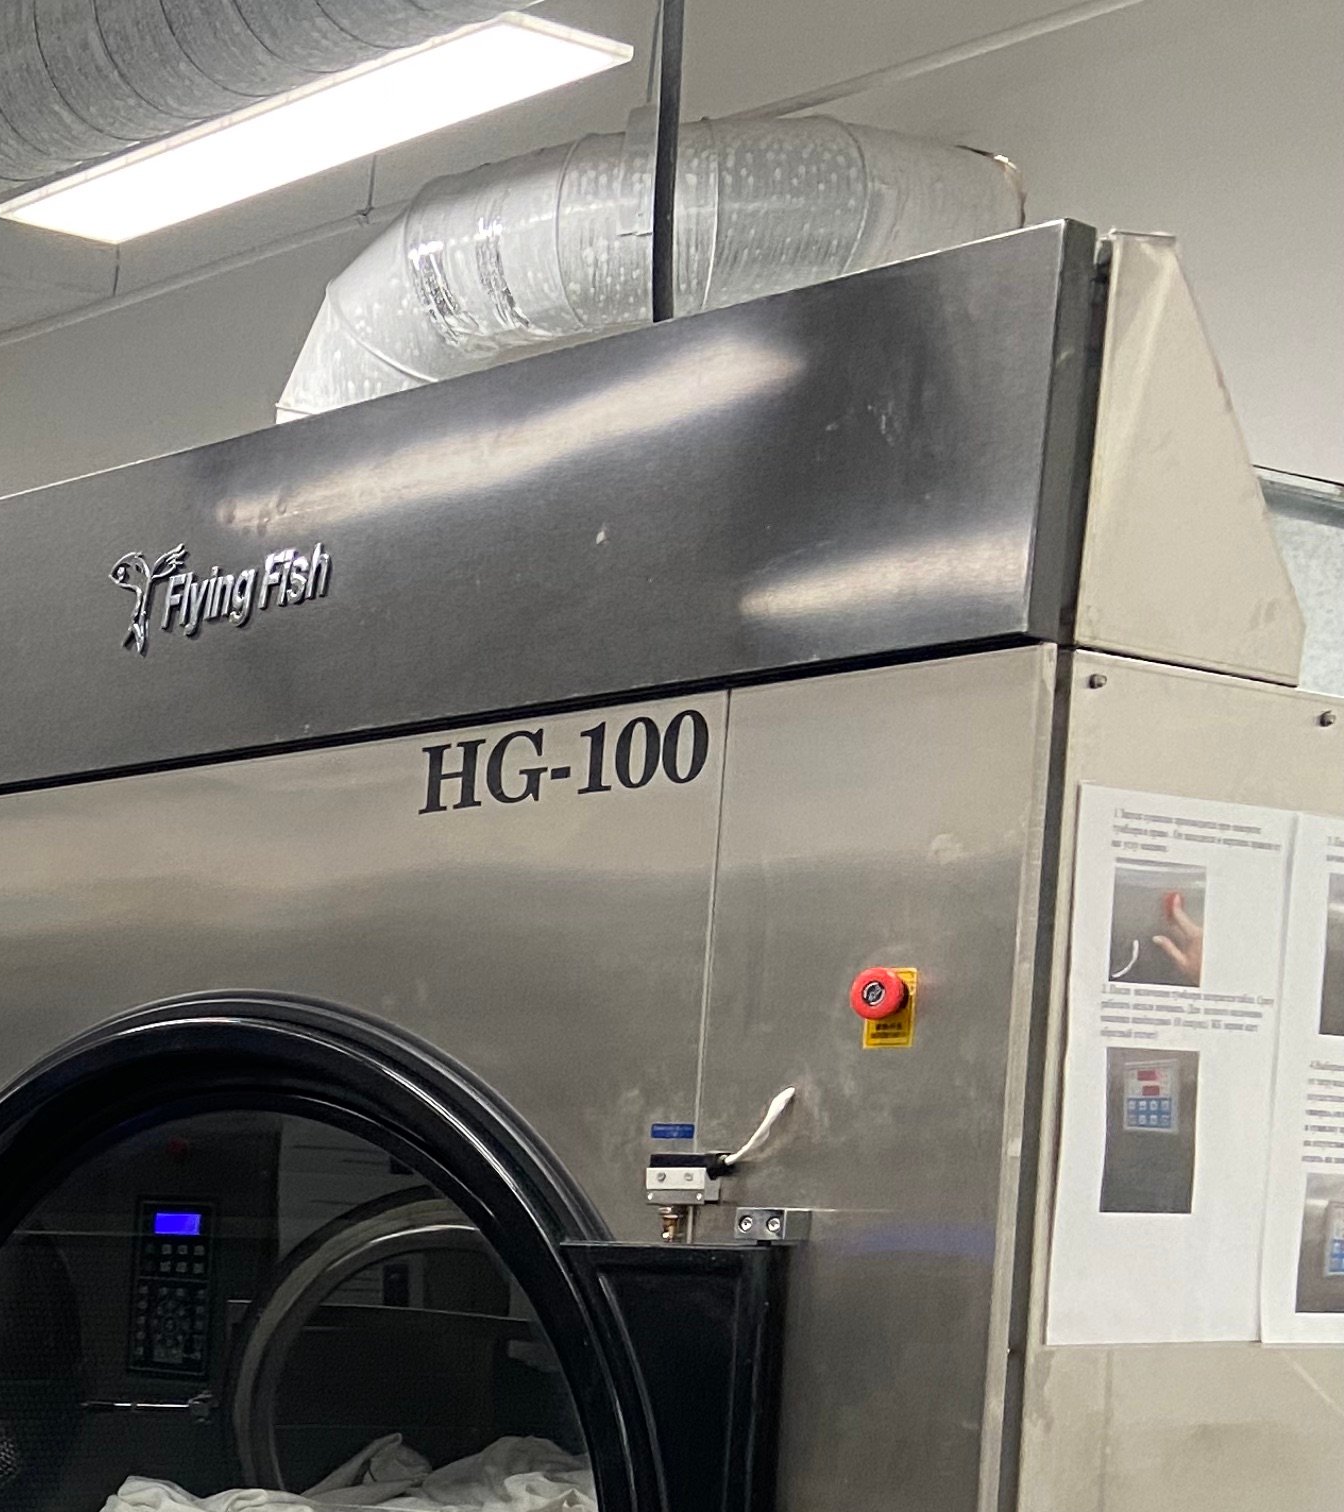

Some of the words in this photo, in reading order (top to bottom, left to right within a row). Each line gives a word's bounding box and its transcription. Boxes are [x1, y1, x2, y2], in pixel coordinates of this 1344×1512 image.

[161, 566, 256, 637] Flying
[258, 542, 332, 610] Fish
[418, 709, 709, 814] HG-100
